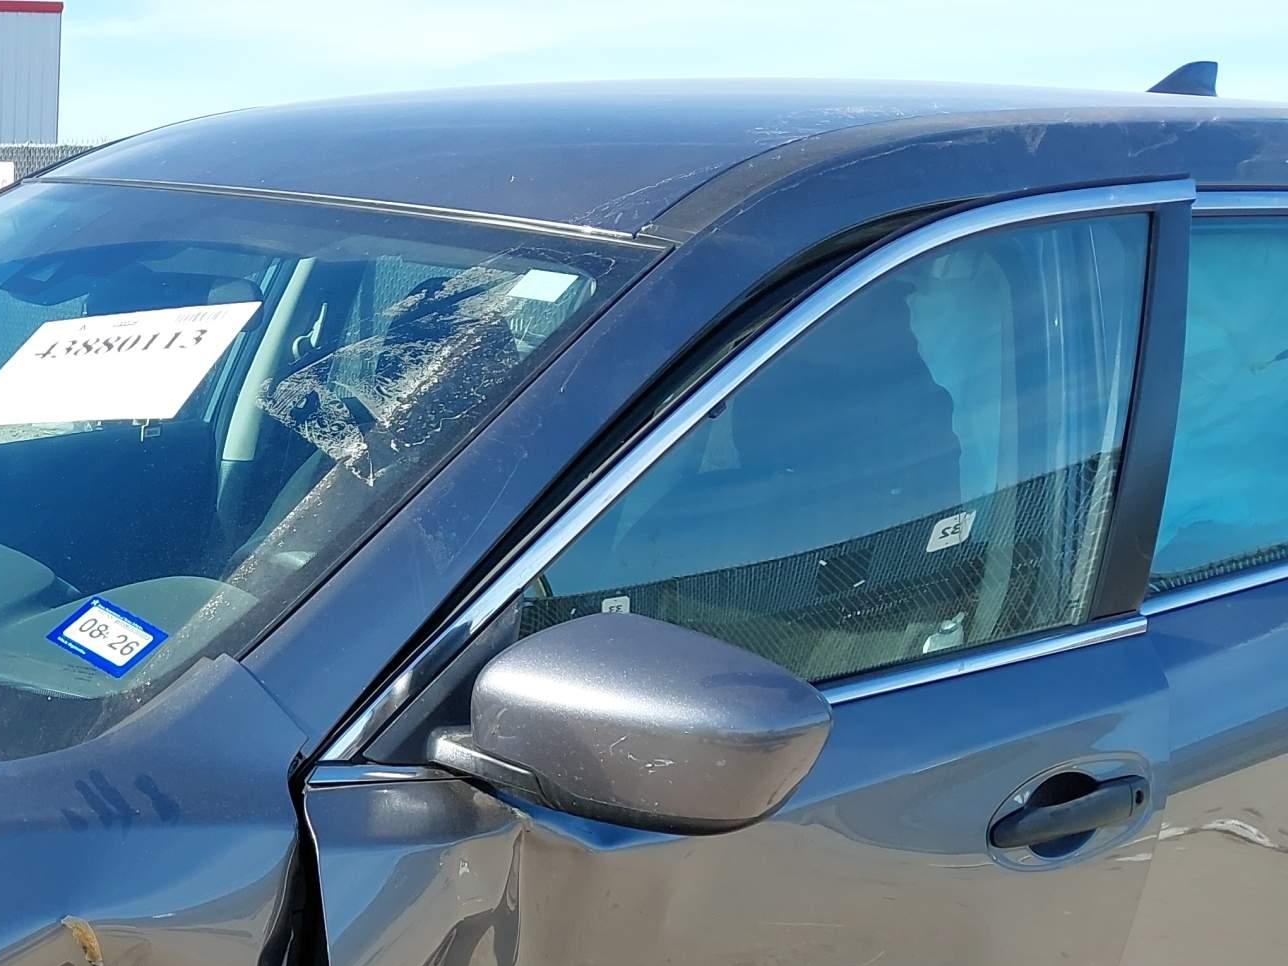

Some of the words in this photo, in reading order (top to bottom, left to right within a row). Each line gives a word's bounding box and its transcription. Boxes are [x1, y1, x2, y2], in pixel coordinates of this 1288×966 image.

[36, 328, 207, 359] 43880113
[78, 618, 107, 638] 08
[107, 634, 140, 655] 26
